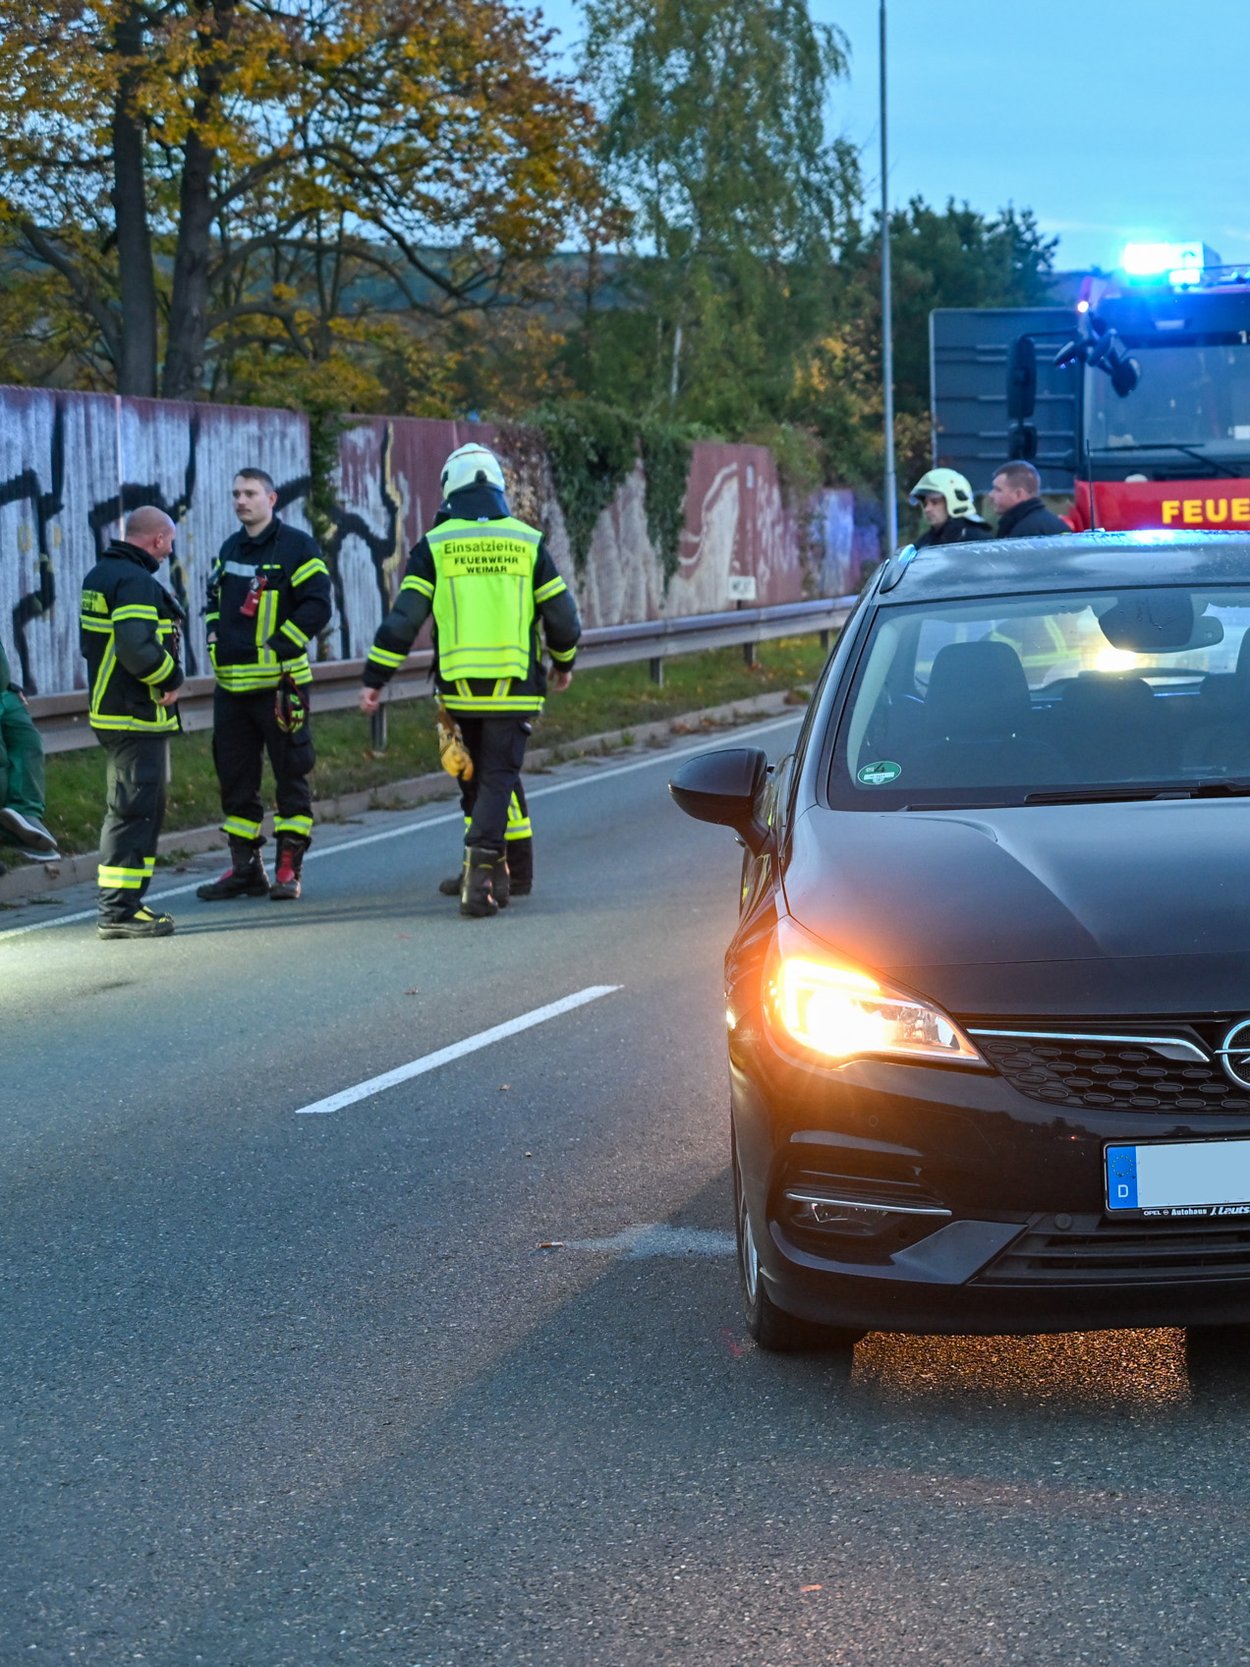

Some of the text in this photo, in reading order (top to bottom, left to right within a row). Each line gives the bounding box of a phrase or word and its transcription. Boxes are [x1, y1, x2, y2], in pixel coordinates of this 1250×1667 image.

[444, 541, 526, 555] Einsatzleiter
[454, 555, 519, 565] FEUERWEHR
[466, 565, 508, 574] WEIMAR
[1117, 1184, 1129, 1198] D
[1171, 1208, 1208, 1216] Autohaus
